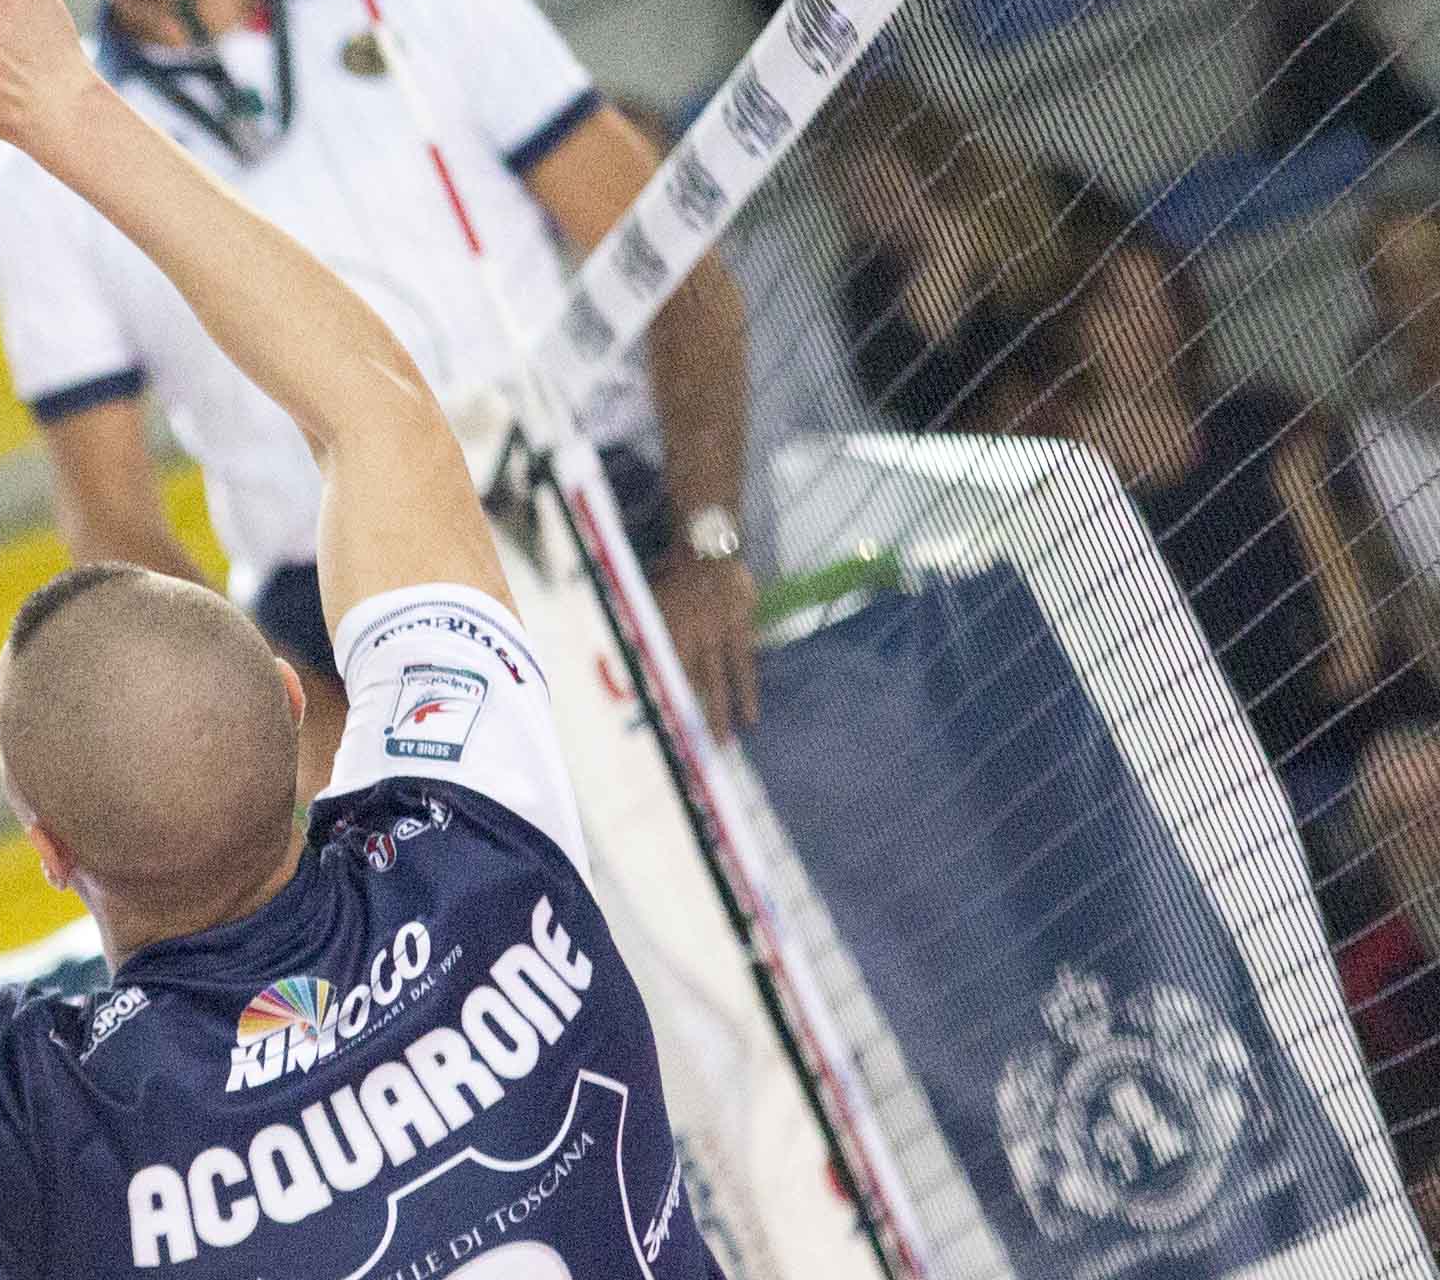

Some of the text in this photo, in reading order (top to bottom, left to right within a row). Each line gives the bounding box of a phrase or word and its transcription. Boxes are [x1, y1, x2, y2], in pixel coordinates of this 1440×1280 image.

[126, 894, 595, 1269] ACQUARONE
[448, 1226, 484, 1261] DI
[485, 1130, 596, 1235] TOSCANA
